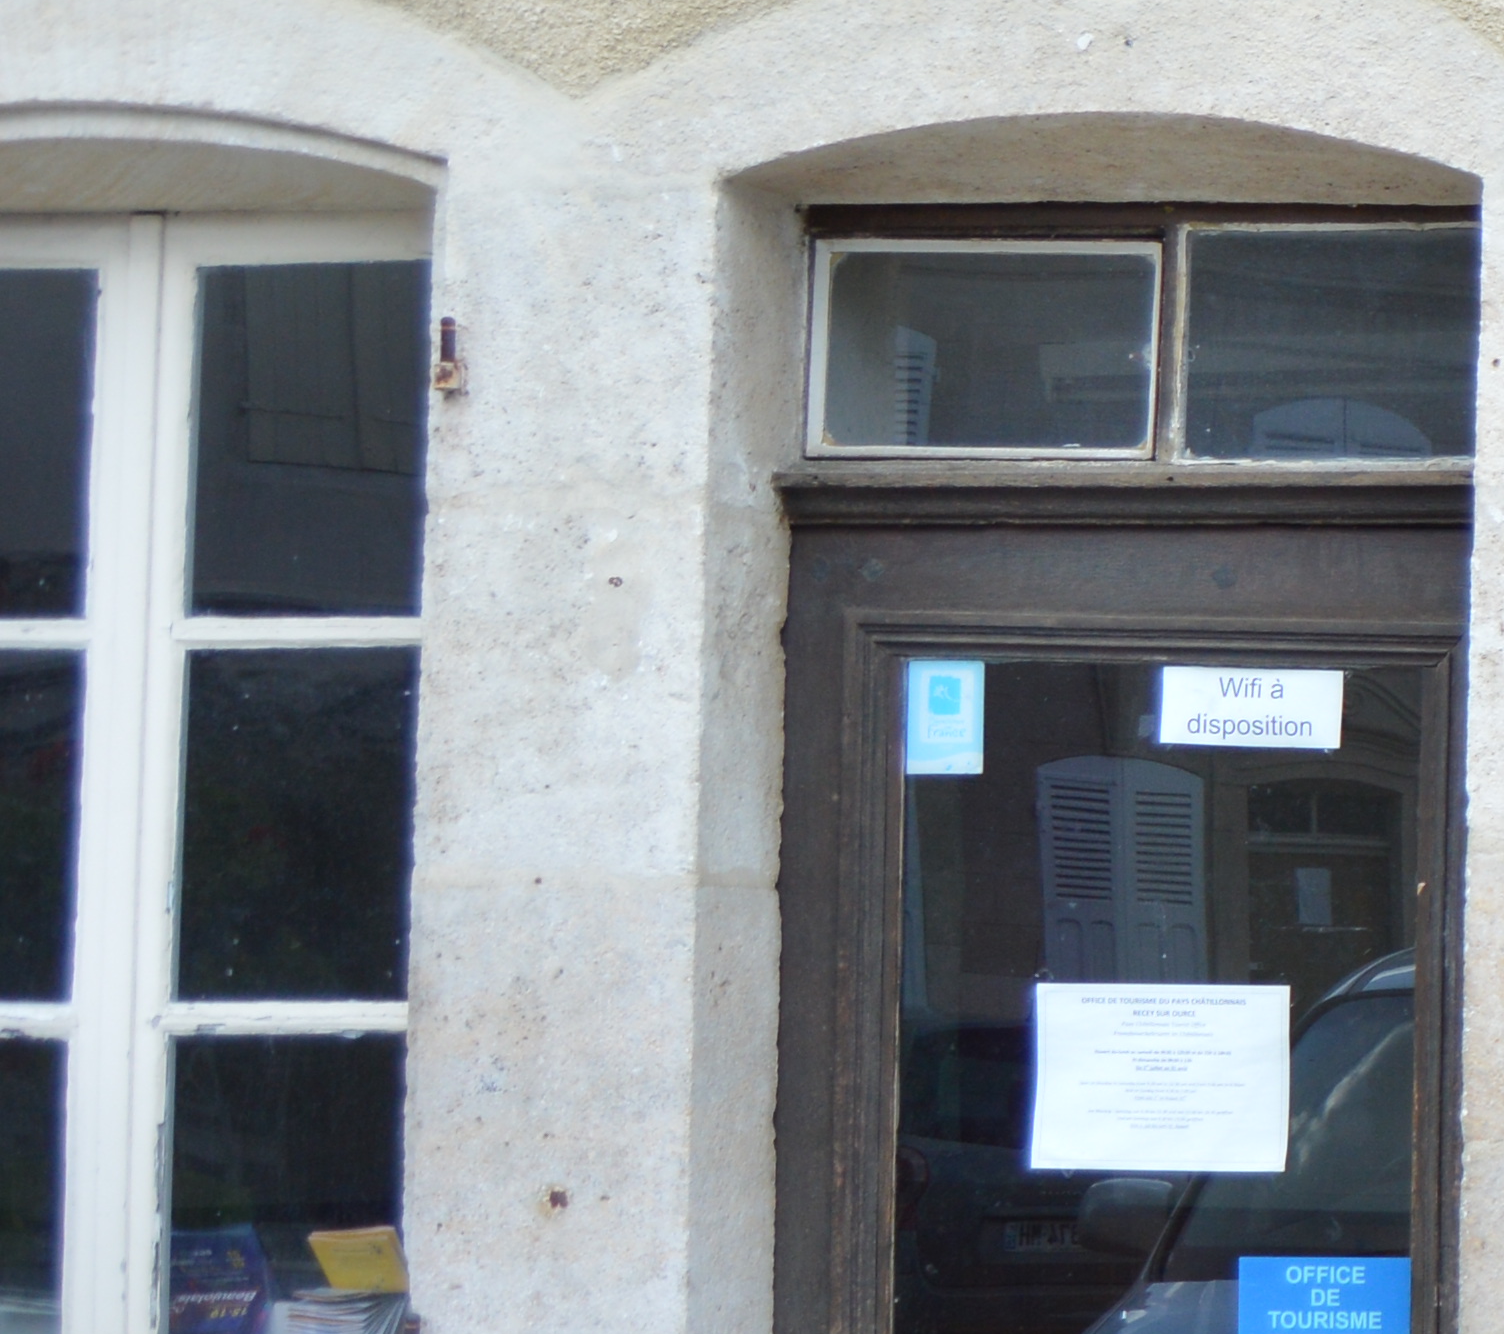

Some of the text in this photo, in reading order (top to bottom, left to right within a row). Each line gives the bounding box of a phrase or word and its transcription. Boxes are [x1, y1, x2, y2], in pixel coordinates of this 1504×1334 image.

[1218, 676, 1284, 699] Wifi à
[1187, 713, 1313, 740] disposition
[1081, 996, 1107, 1005] OFFICE
[1107, 997, 1118, 1005] DE
[1119, 997, 1158, 1006] TOURISME
[1285, 1265, 1366, 1285] OFFICE
[1310, 1288, 1341, 1307] DE
[1267, 1310, 1383, 1330] TOURISME
